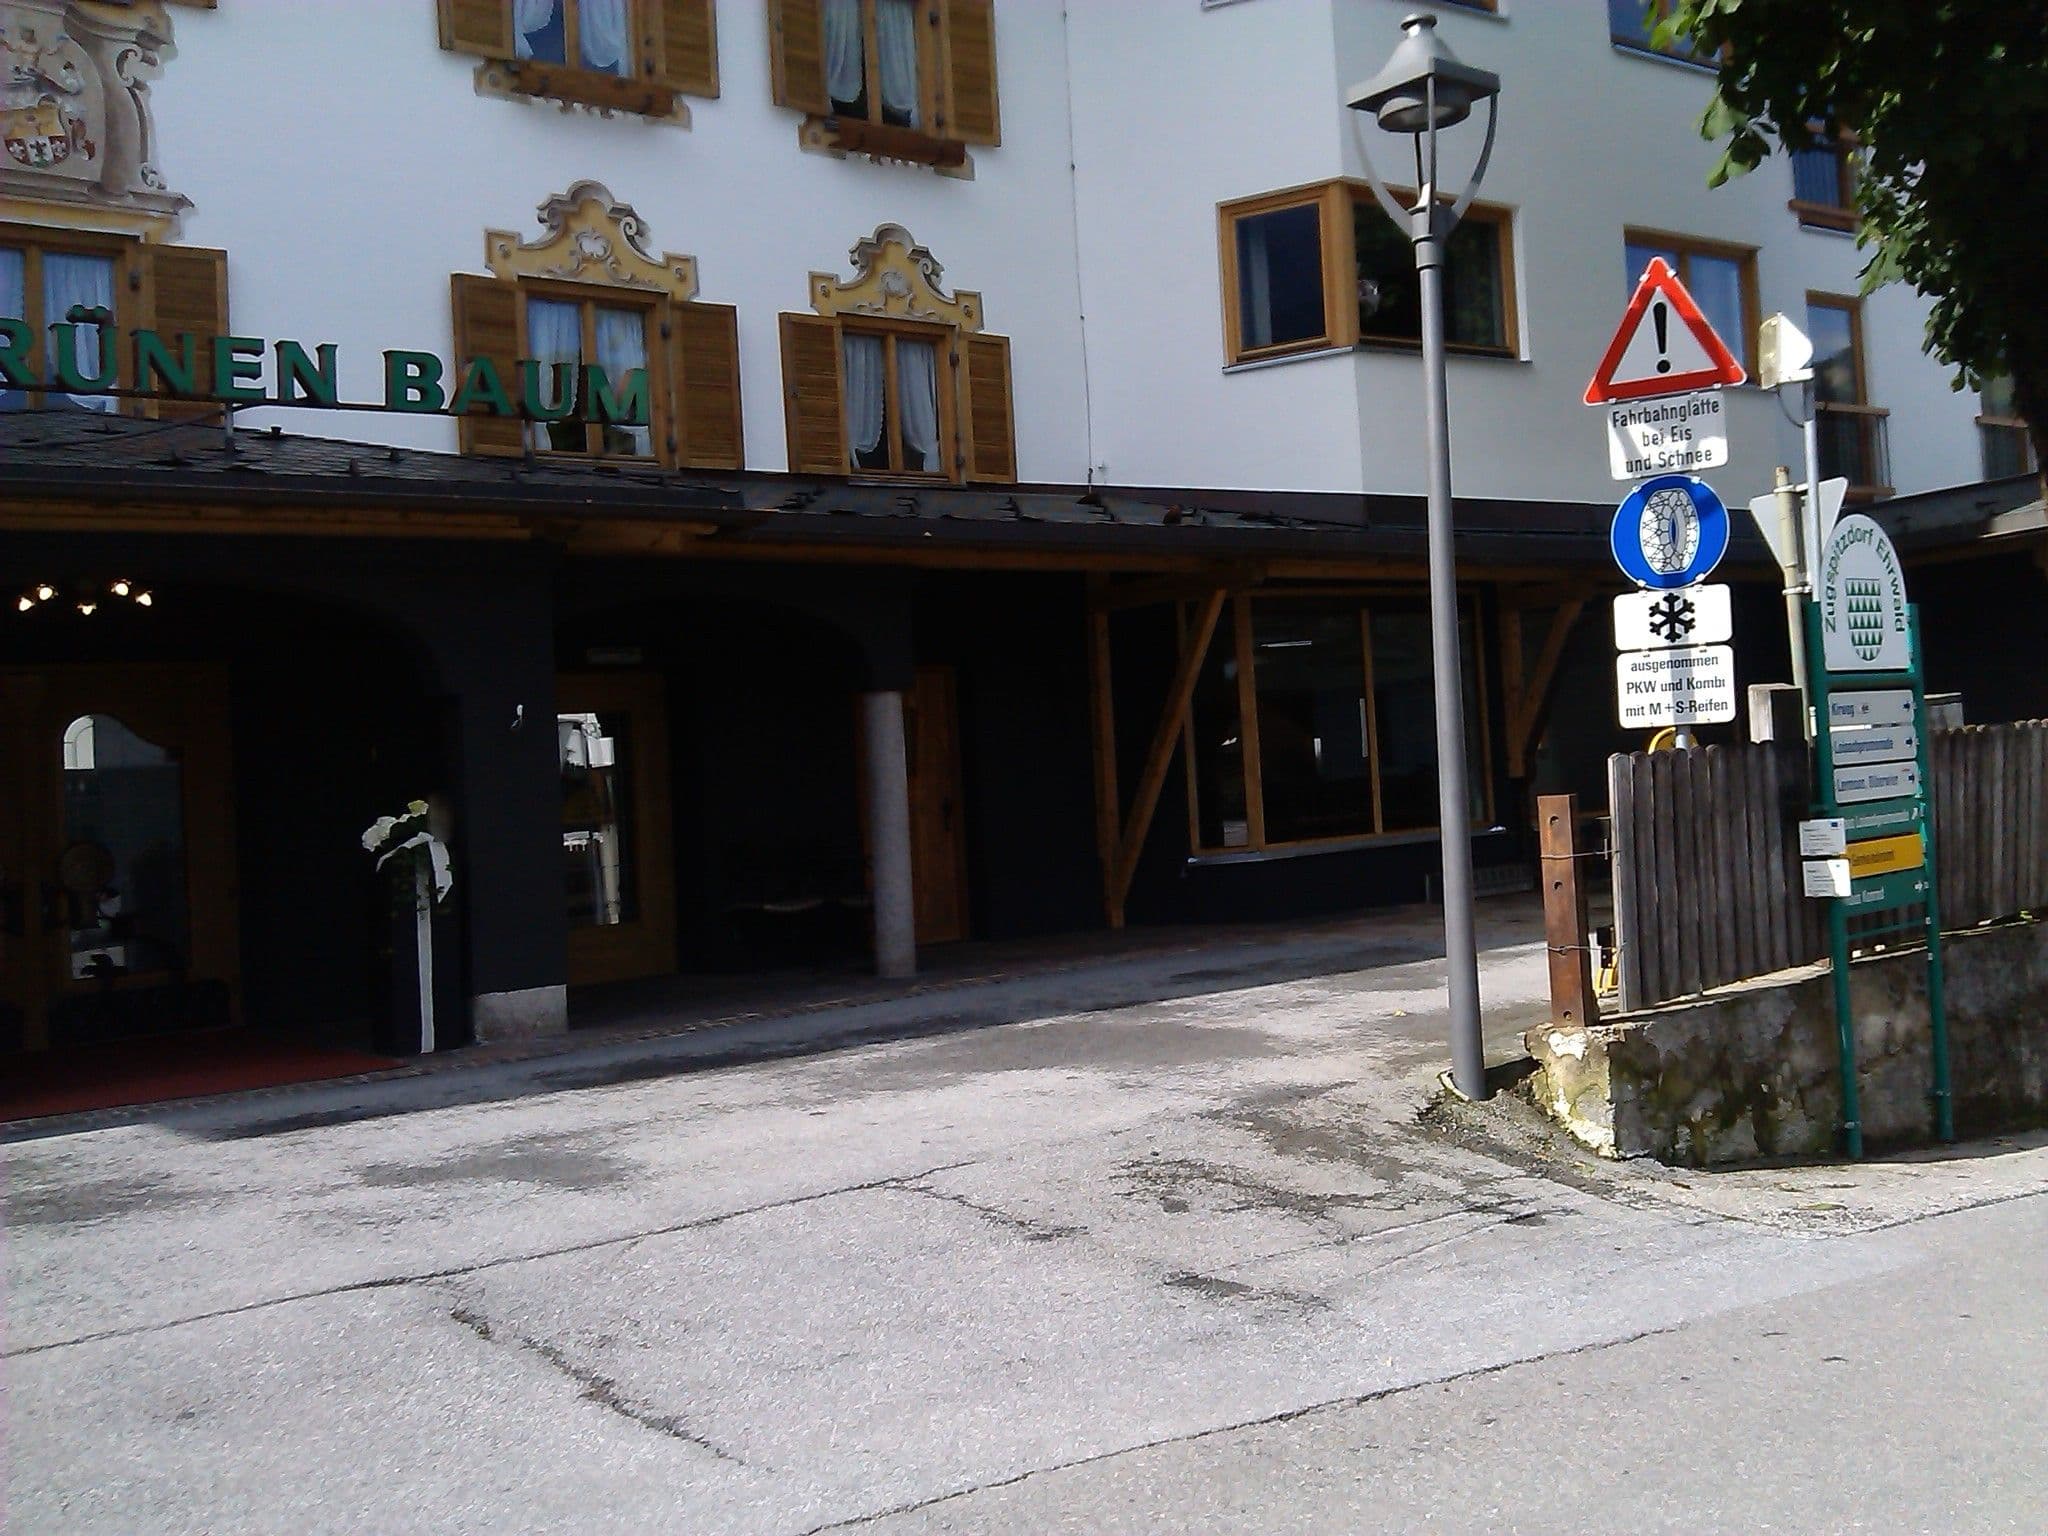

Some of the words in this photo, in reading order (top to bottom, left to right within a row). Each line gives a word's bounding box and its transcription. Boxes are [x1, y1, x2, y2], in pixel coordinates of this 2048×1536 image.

[382, 349, 649, 422] BAUM
[1612, 399, 1720, 428] Fahrbahnglätte
[1642, 427, 1664, 446] bei
[1671, 425, 1692, 442] Eis
[1626, 453, 1652, 473] und
[1658, 449, 1712, 468] Schnee
[1825, 524, 1874, 633] Zugspitzdorf
[1875, 538, 1905, 633] Ehrwald
[1630, 656, 1719, 673] ausgenommen
[1626, 680, 1657, 694] PKW
[1660, 678, 1682, 692] und
[1687, 676, 1726, 690] Kombi
[1625, 704, 1645, 717] mit
